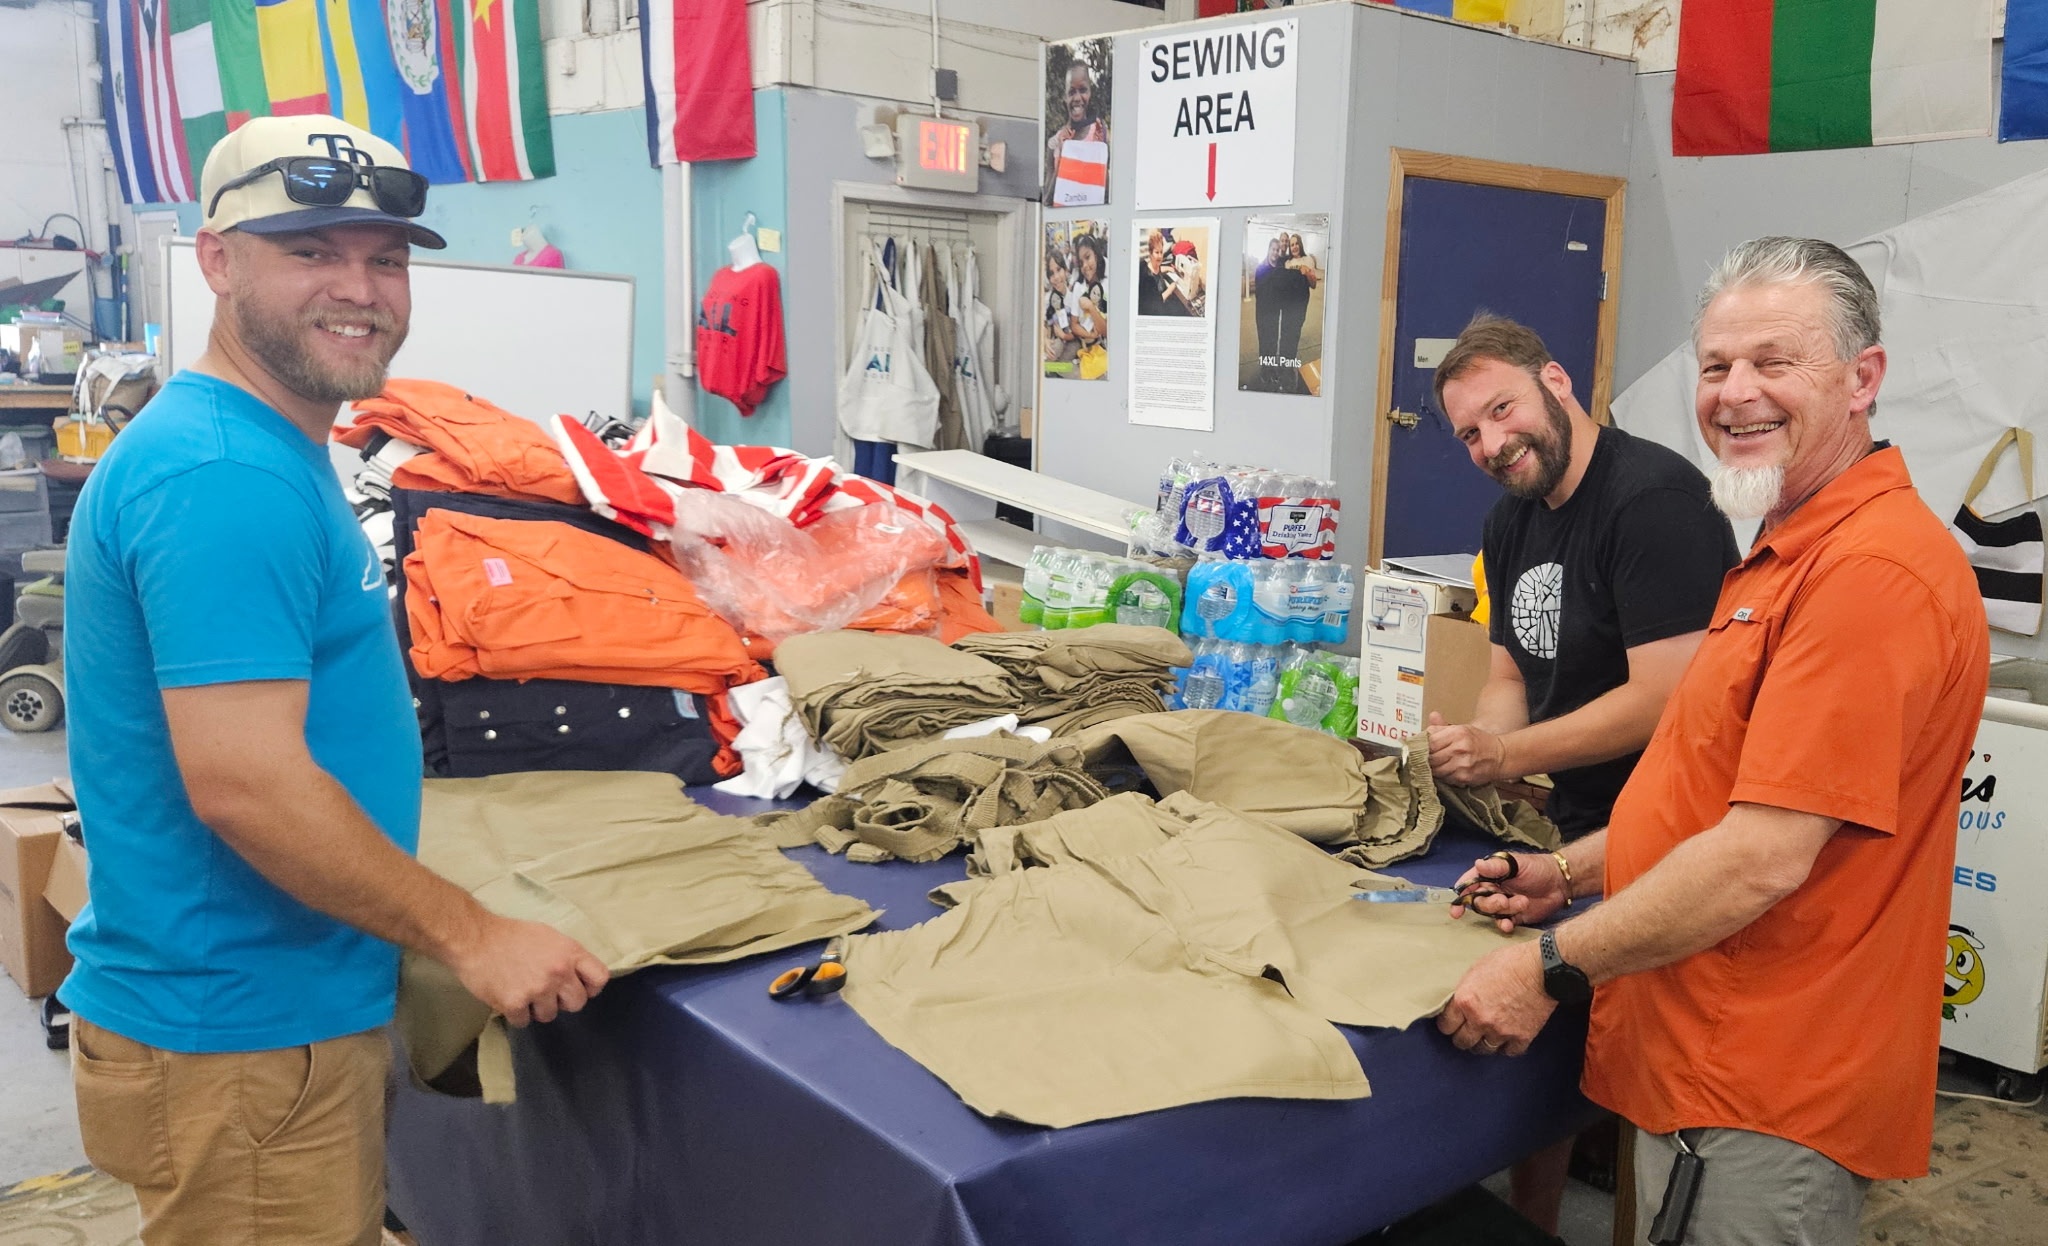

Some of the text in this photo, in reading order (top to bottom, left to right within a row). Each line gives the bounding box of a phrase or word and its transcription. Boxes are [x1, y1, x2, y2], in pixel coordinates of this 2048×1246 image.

[1150, 27, 1286, 83] SEWING
[1173, 90, 1256, 138] AREA
[919, 121, 970, 174] EXIT
[1064, 192, 1088, 203] Zambia
[1259, 355, 1302, 368] 14XL Pants
[1417, 355, 1429, 363] Men
[1395, 708, 1403, 722] 15
[1360, 719, 1417, 740] SINGE
